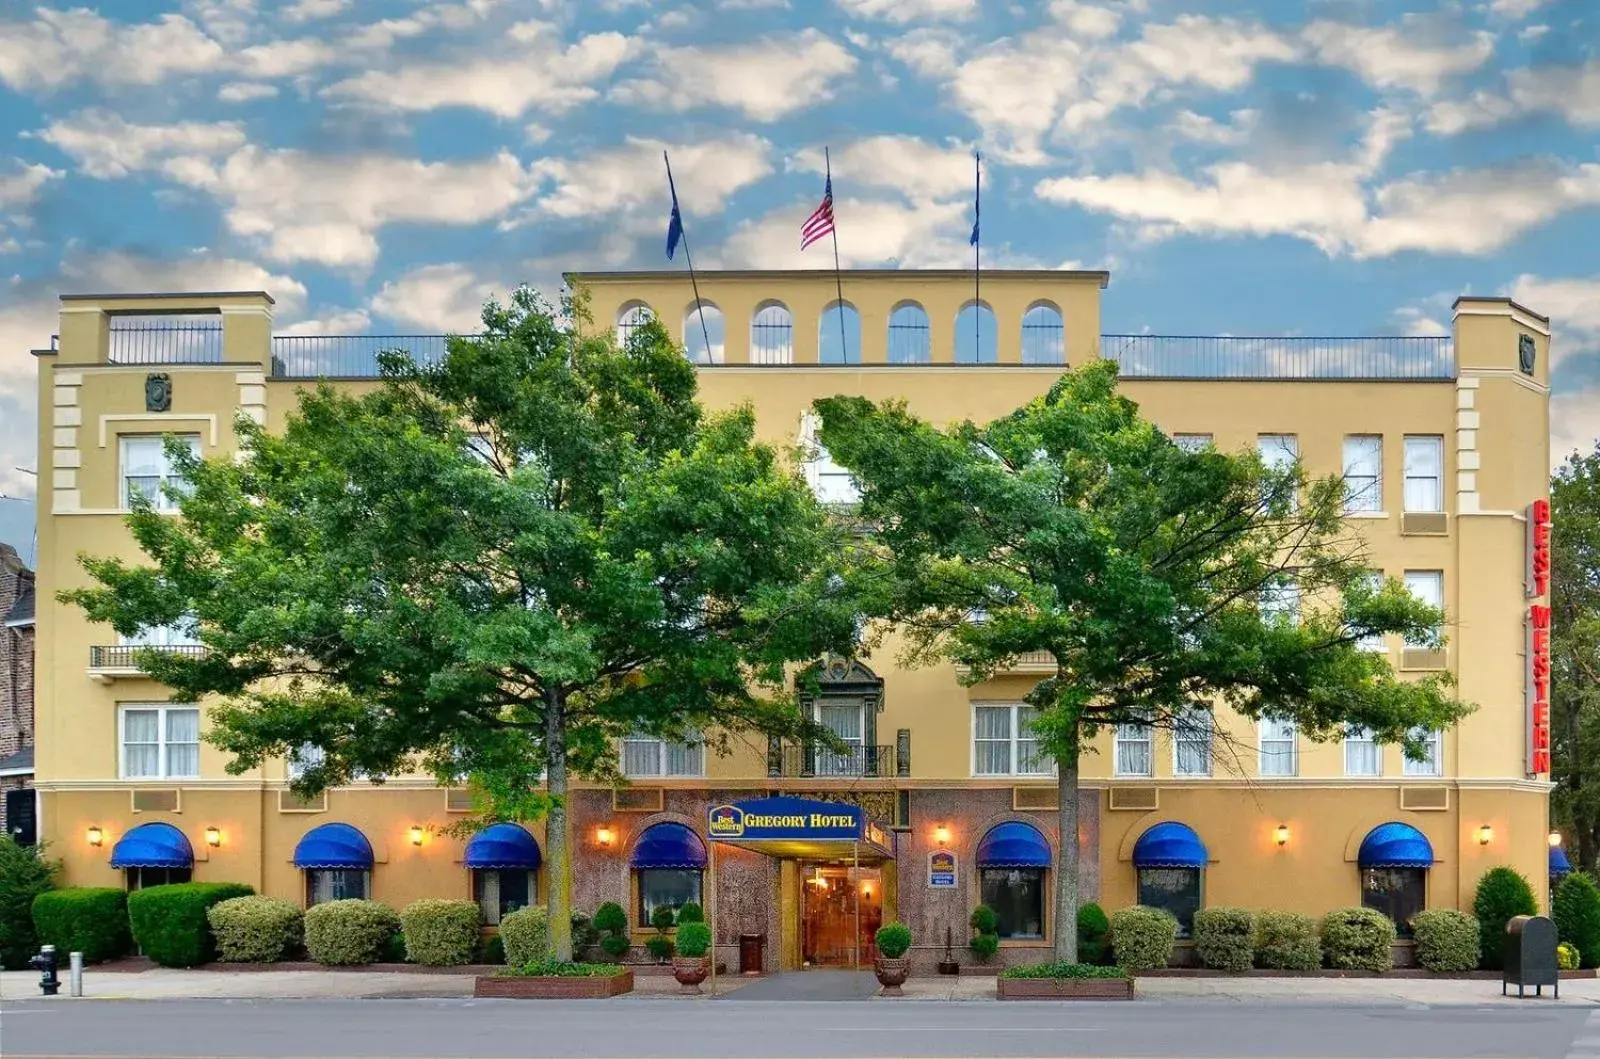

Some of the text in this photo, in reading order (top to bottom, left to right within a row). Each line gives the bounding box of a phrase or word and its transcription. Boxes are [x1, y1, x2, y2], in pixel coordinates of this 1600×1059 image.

[1533, 499, 1549, 596] BEST
[1531, 605, 1551, 773] WESTERN
[718, 815, 735, 824] Best
[745, 814, 856, 828] GREGORY HOTEL
